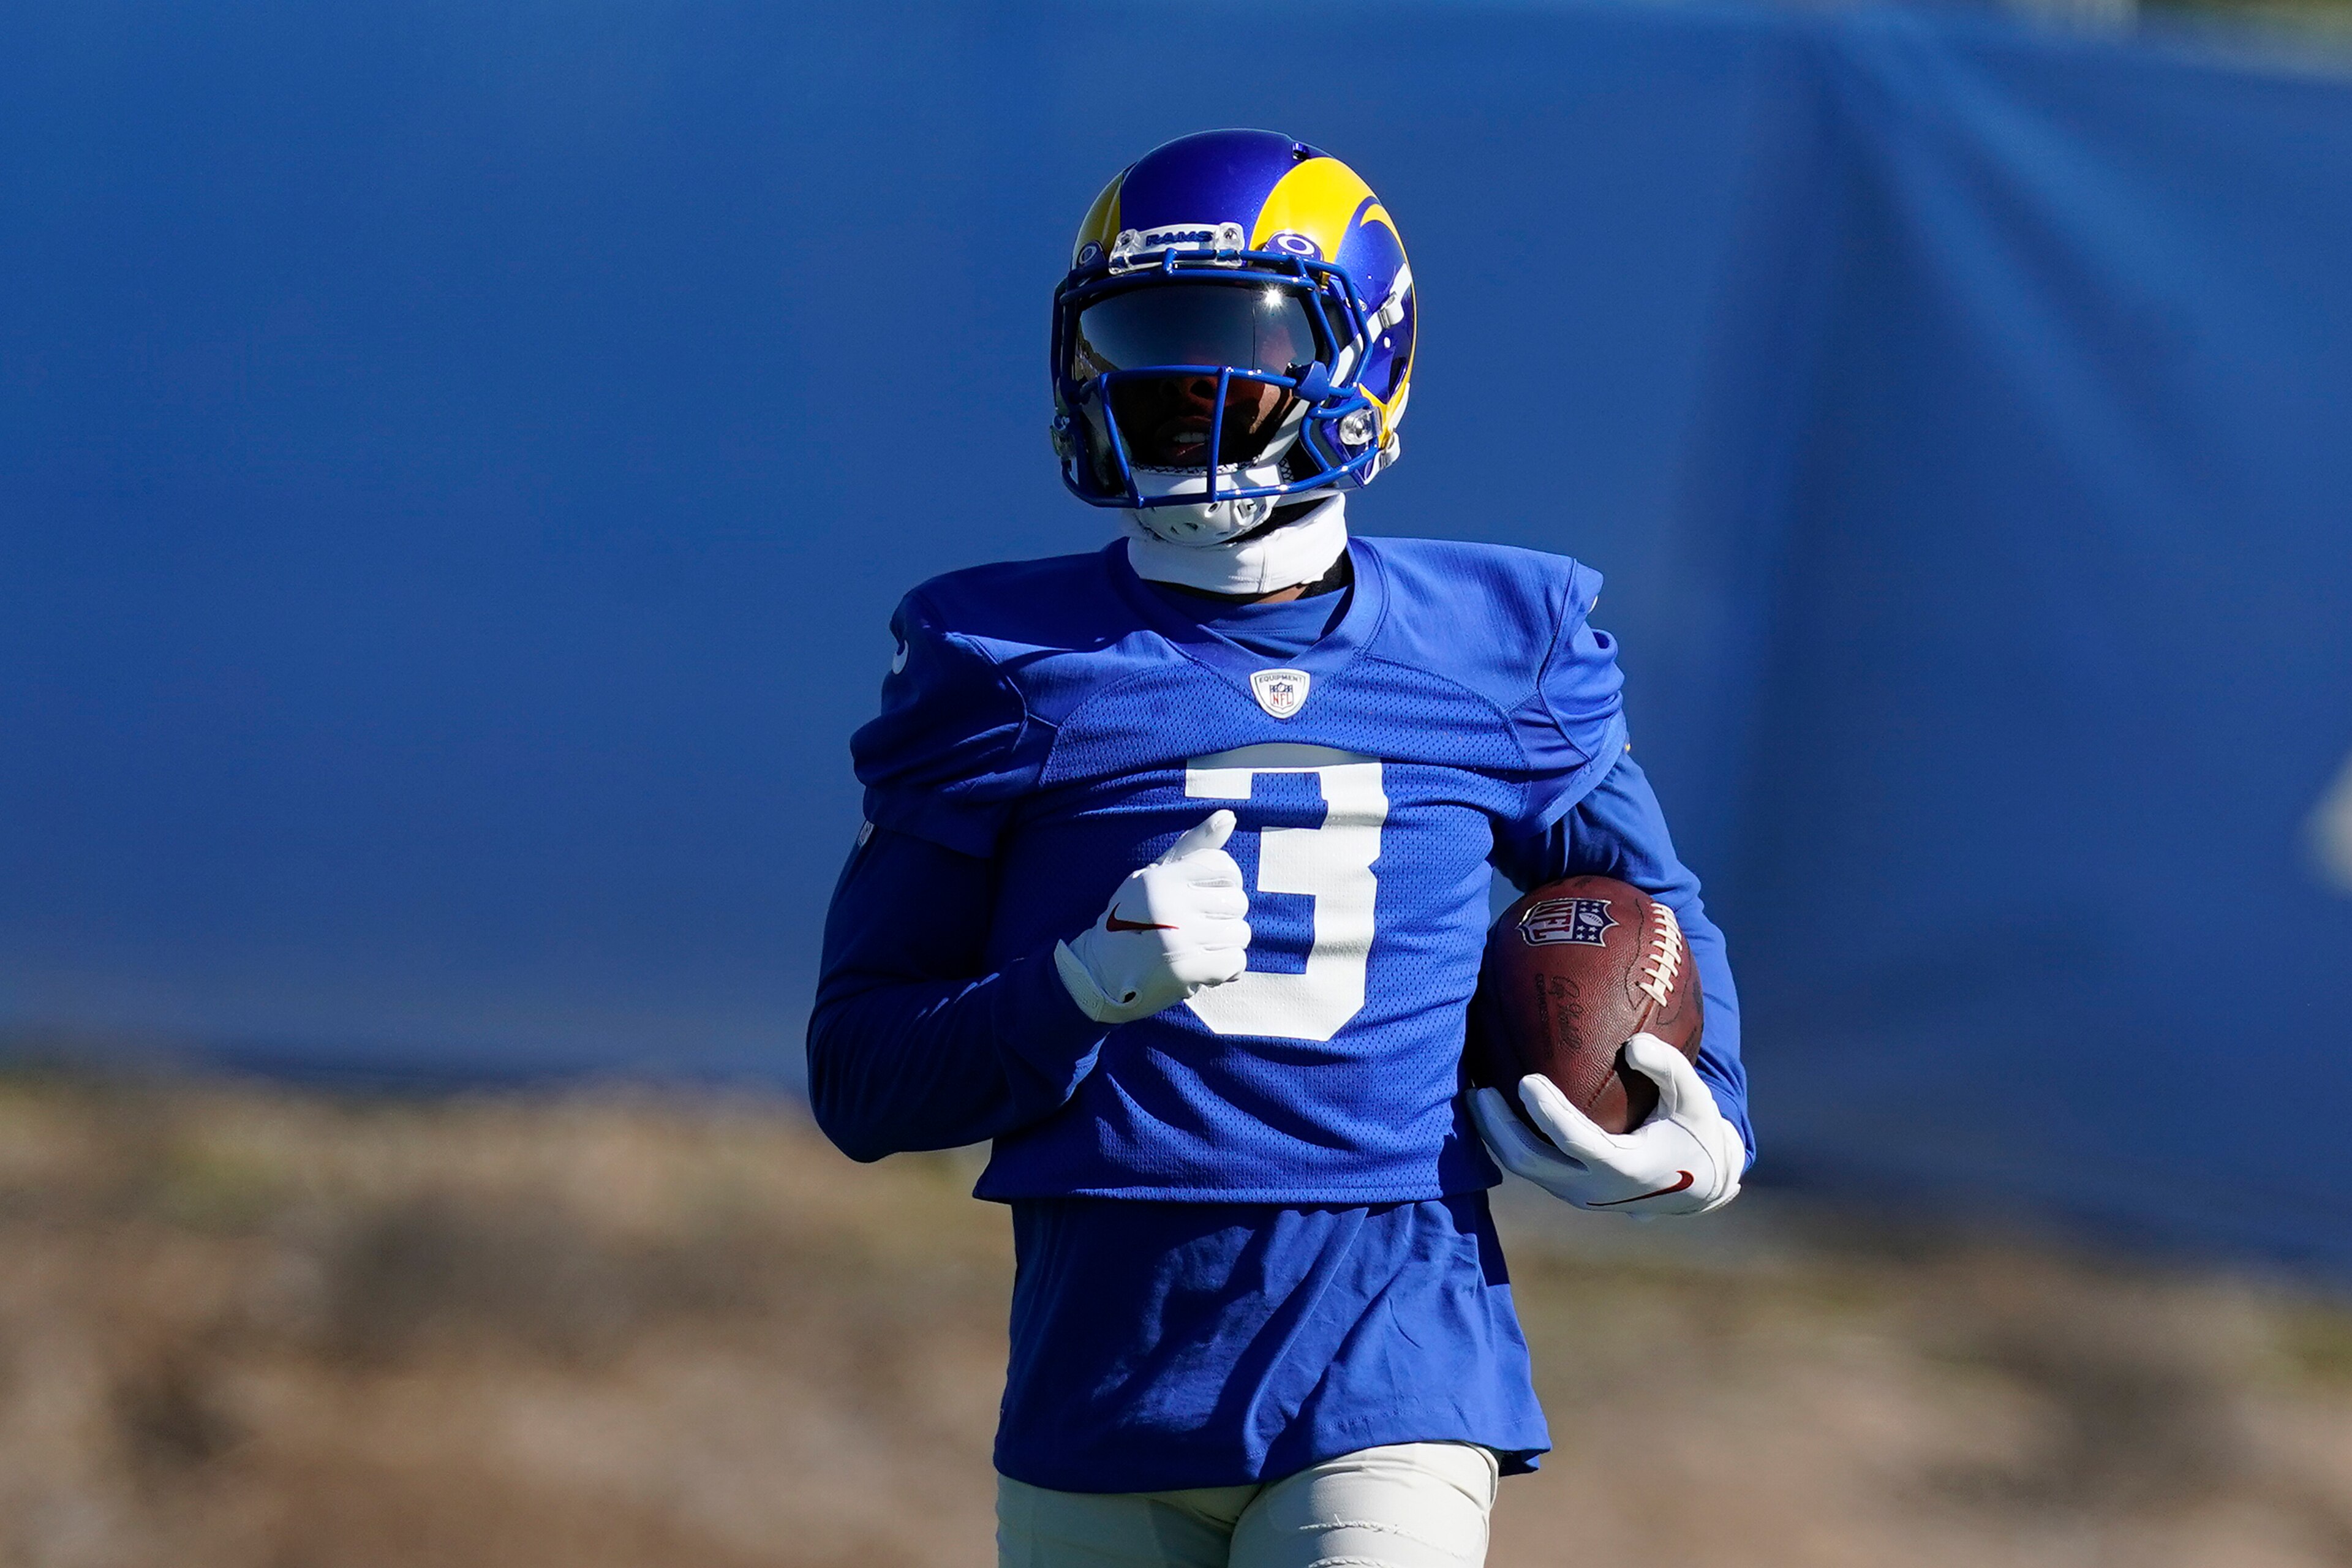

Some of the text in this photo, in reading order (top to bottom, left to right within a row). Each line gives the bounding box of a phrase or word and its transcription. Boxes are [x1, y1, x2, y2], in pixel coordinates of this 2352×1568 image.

[1146, 232, 1213, 246] RAMS
[1259, 674, 1302, 683] EQUIPMENT
[1273, 693, 1292, 706] NFL
[1183, 744, 1389, 1041] 3
[1529, 902, 1573, 940] NFL
